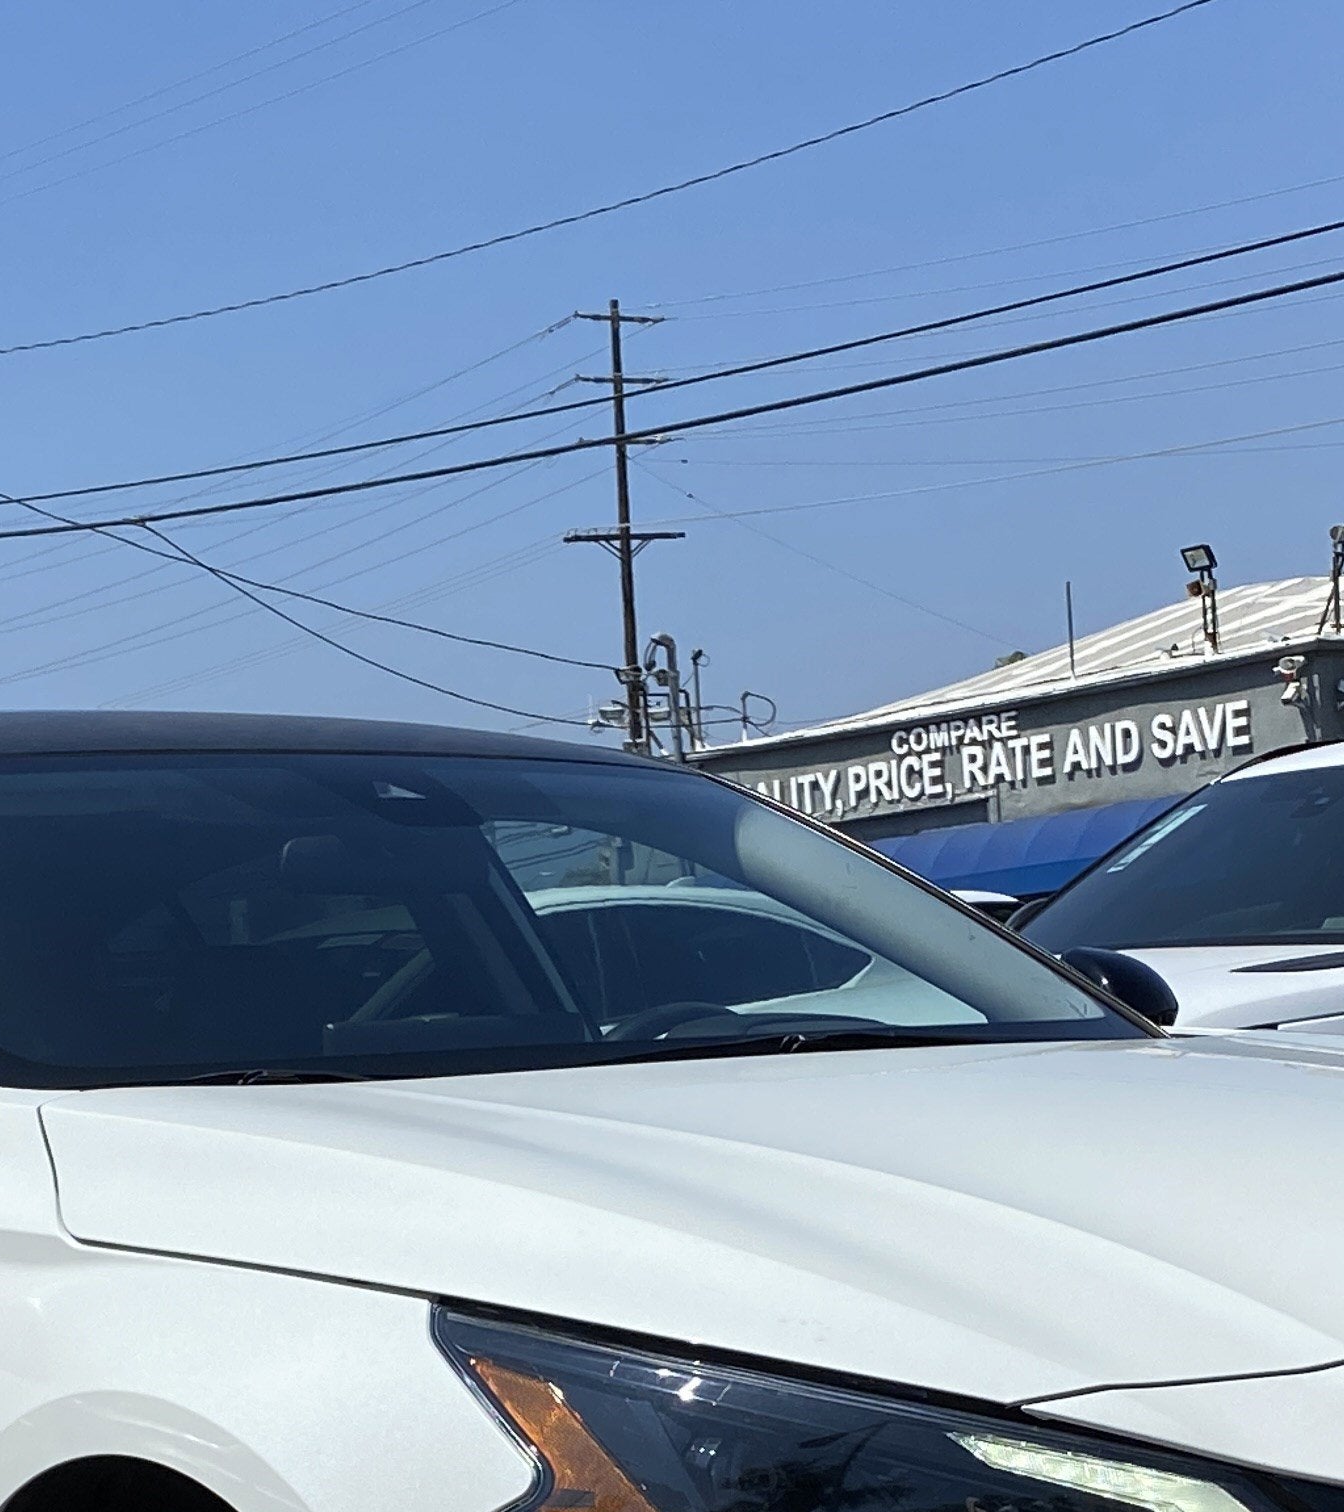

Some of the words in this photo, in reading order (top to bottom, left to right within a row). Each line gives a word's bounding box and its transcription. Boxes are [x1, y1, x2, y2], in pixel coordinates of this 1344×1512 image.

[848, 752, 953, 807] PRICE,
[960, 734, 1053, 789] RATE
[1063, 720, 1140, 774] AND
[1151, 700, 1251, 760] SAVE
[891, 710, 1019, 755] COMPARE
